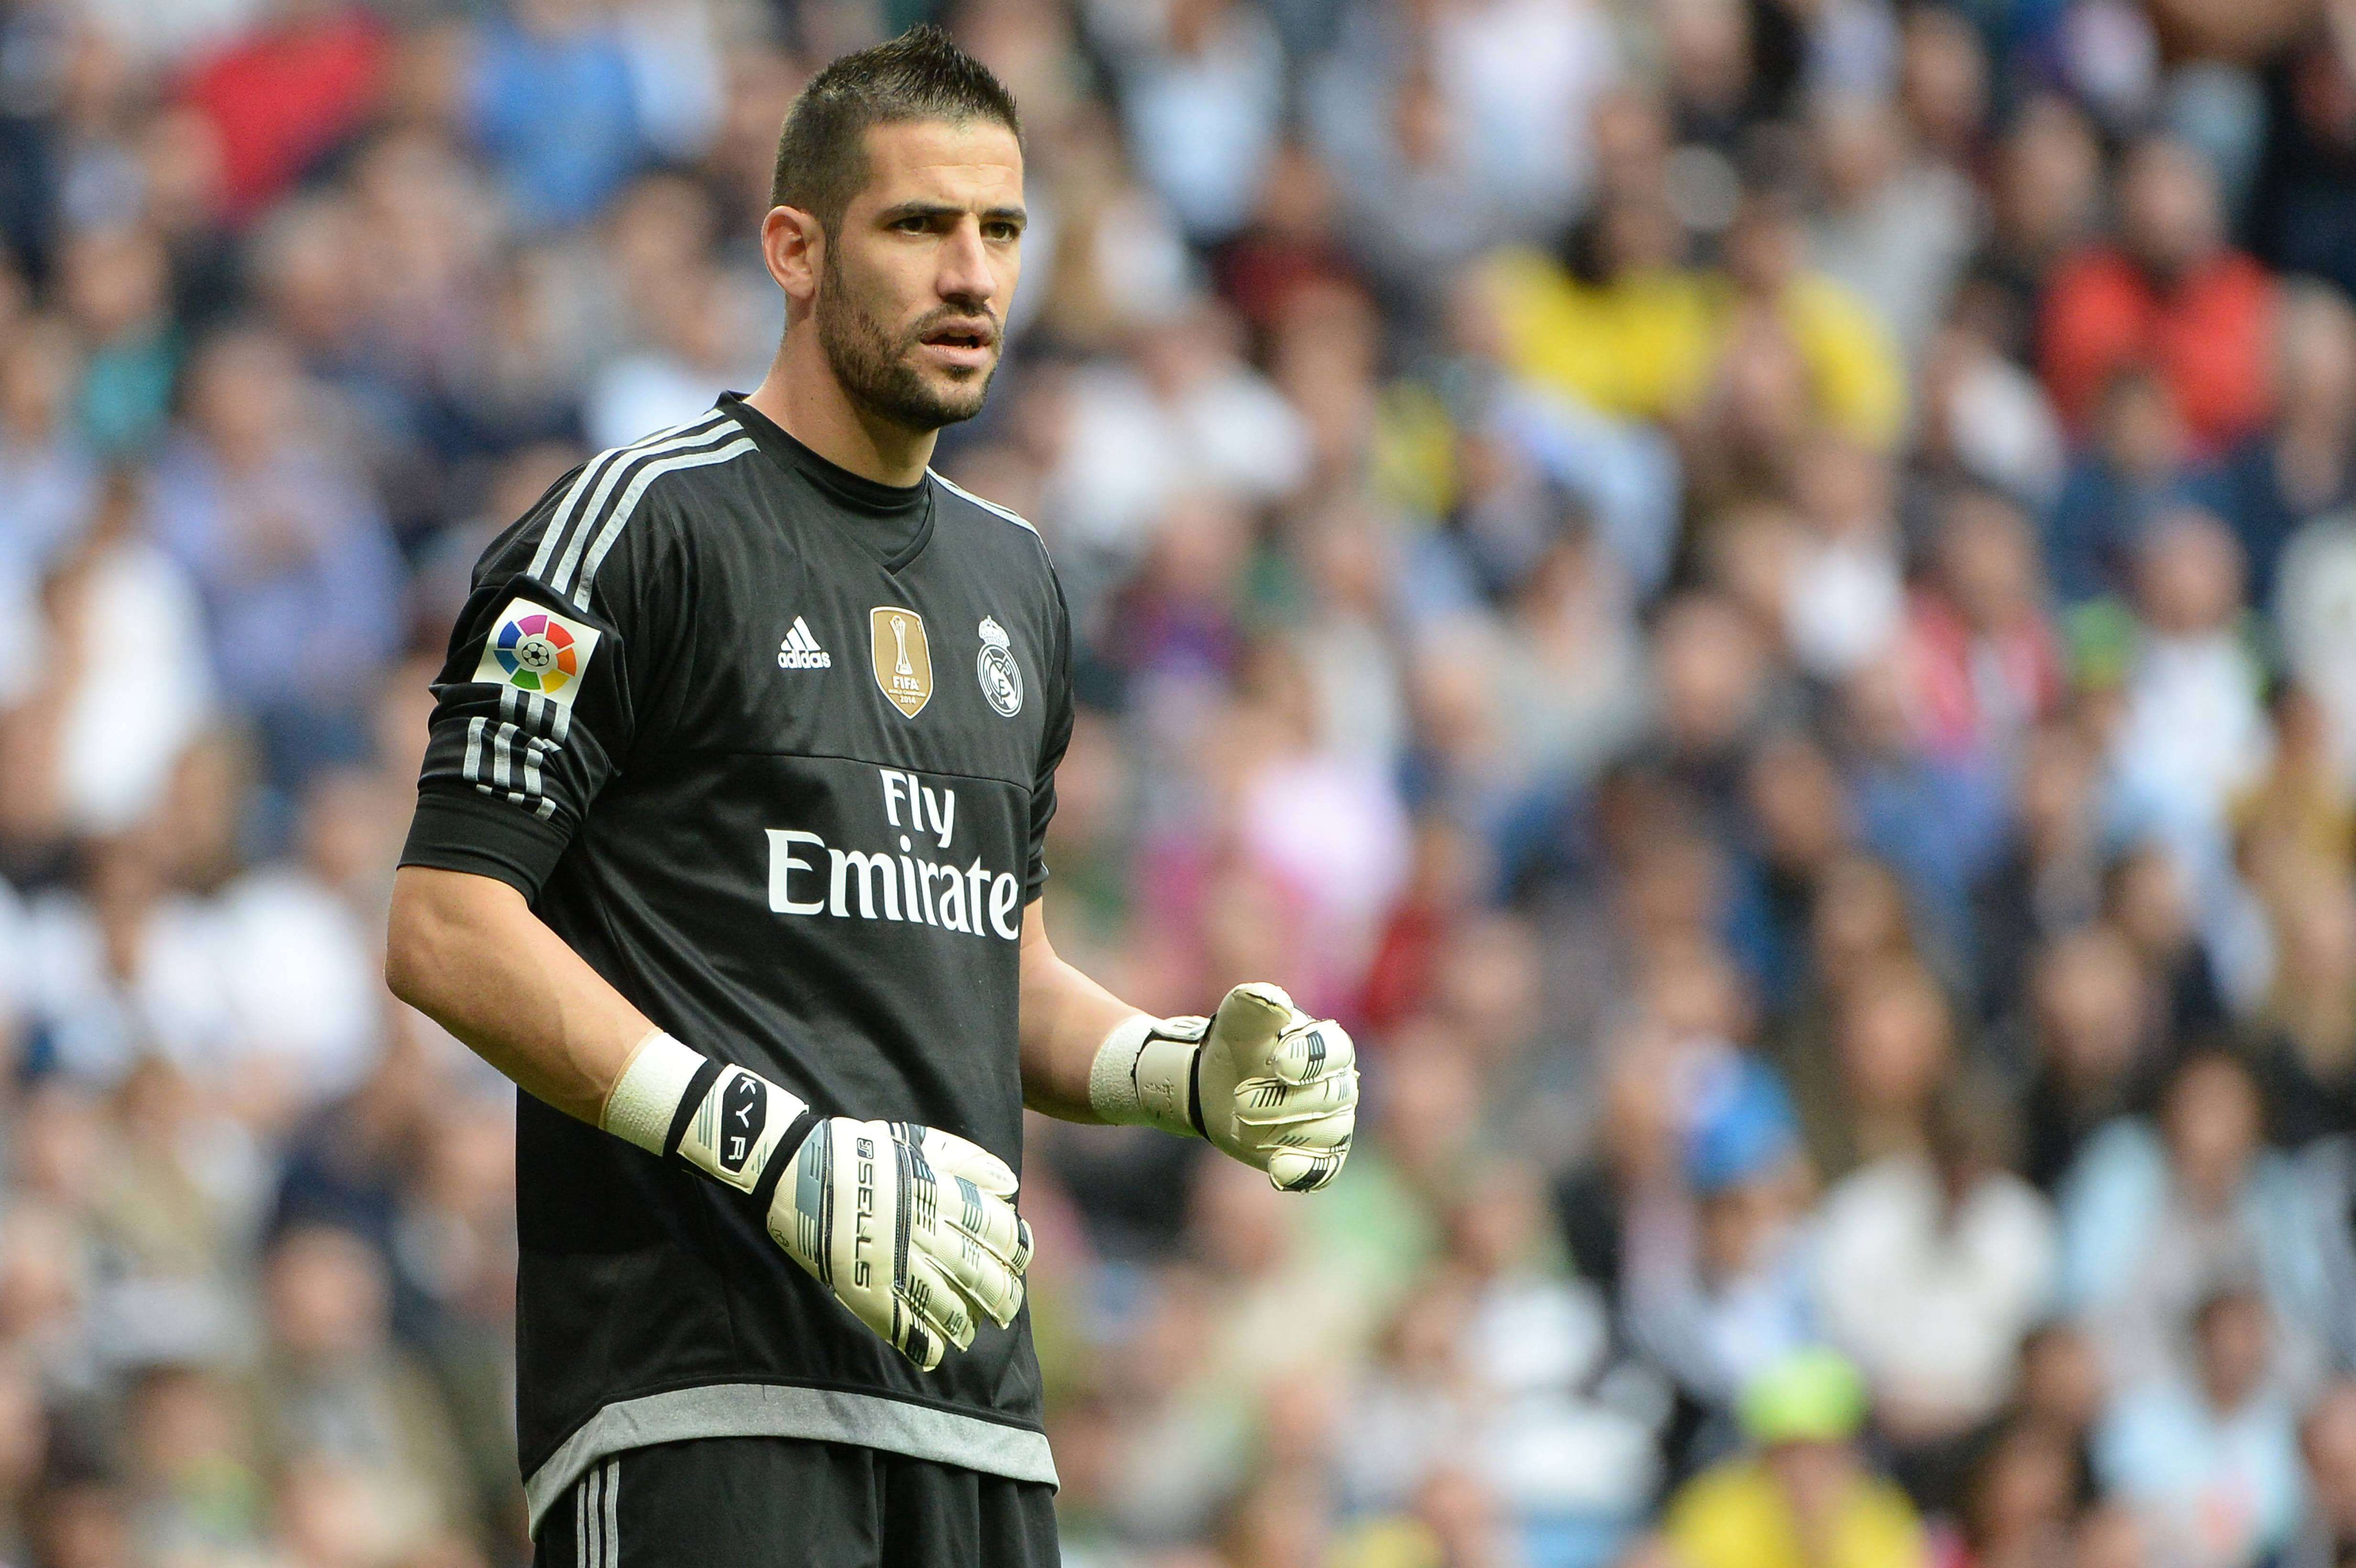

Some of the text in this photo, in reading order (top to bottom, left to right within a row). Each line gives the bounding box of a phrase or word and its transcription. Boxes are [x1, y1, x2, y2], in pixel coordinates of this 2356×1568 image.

[778, 650, 831, 668] adidas
[893, 676, 919, 690] FIFA
[879, 769, 955, 848] Fly
[765, 828, 1019, 940] Emirate
[855, 1161, 873, 1288] SELLS
